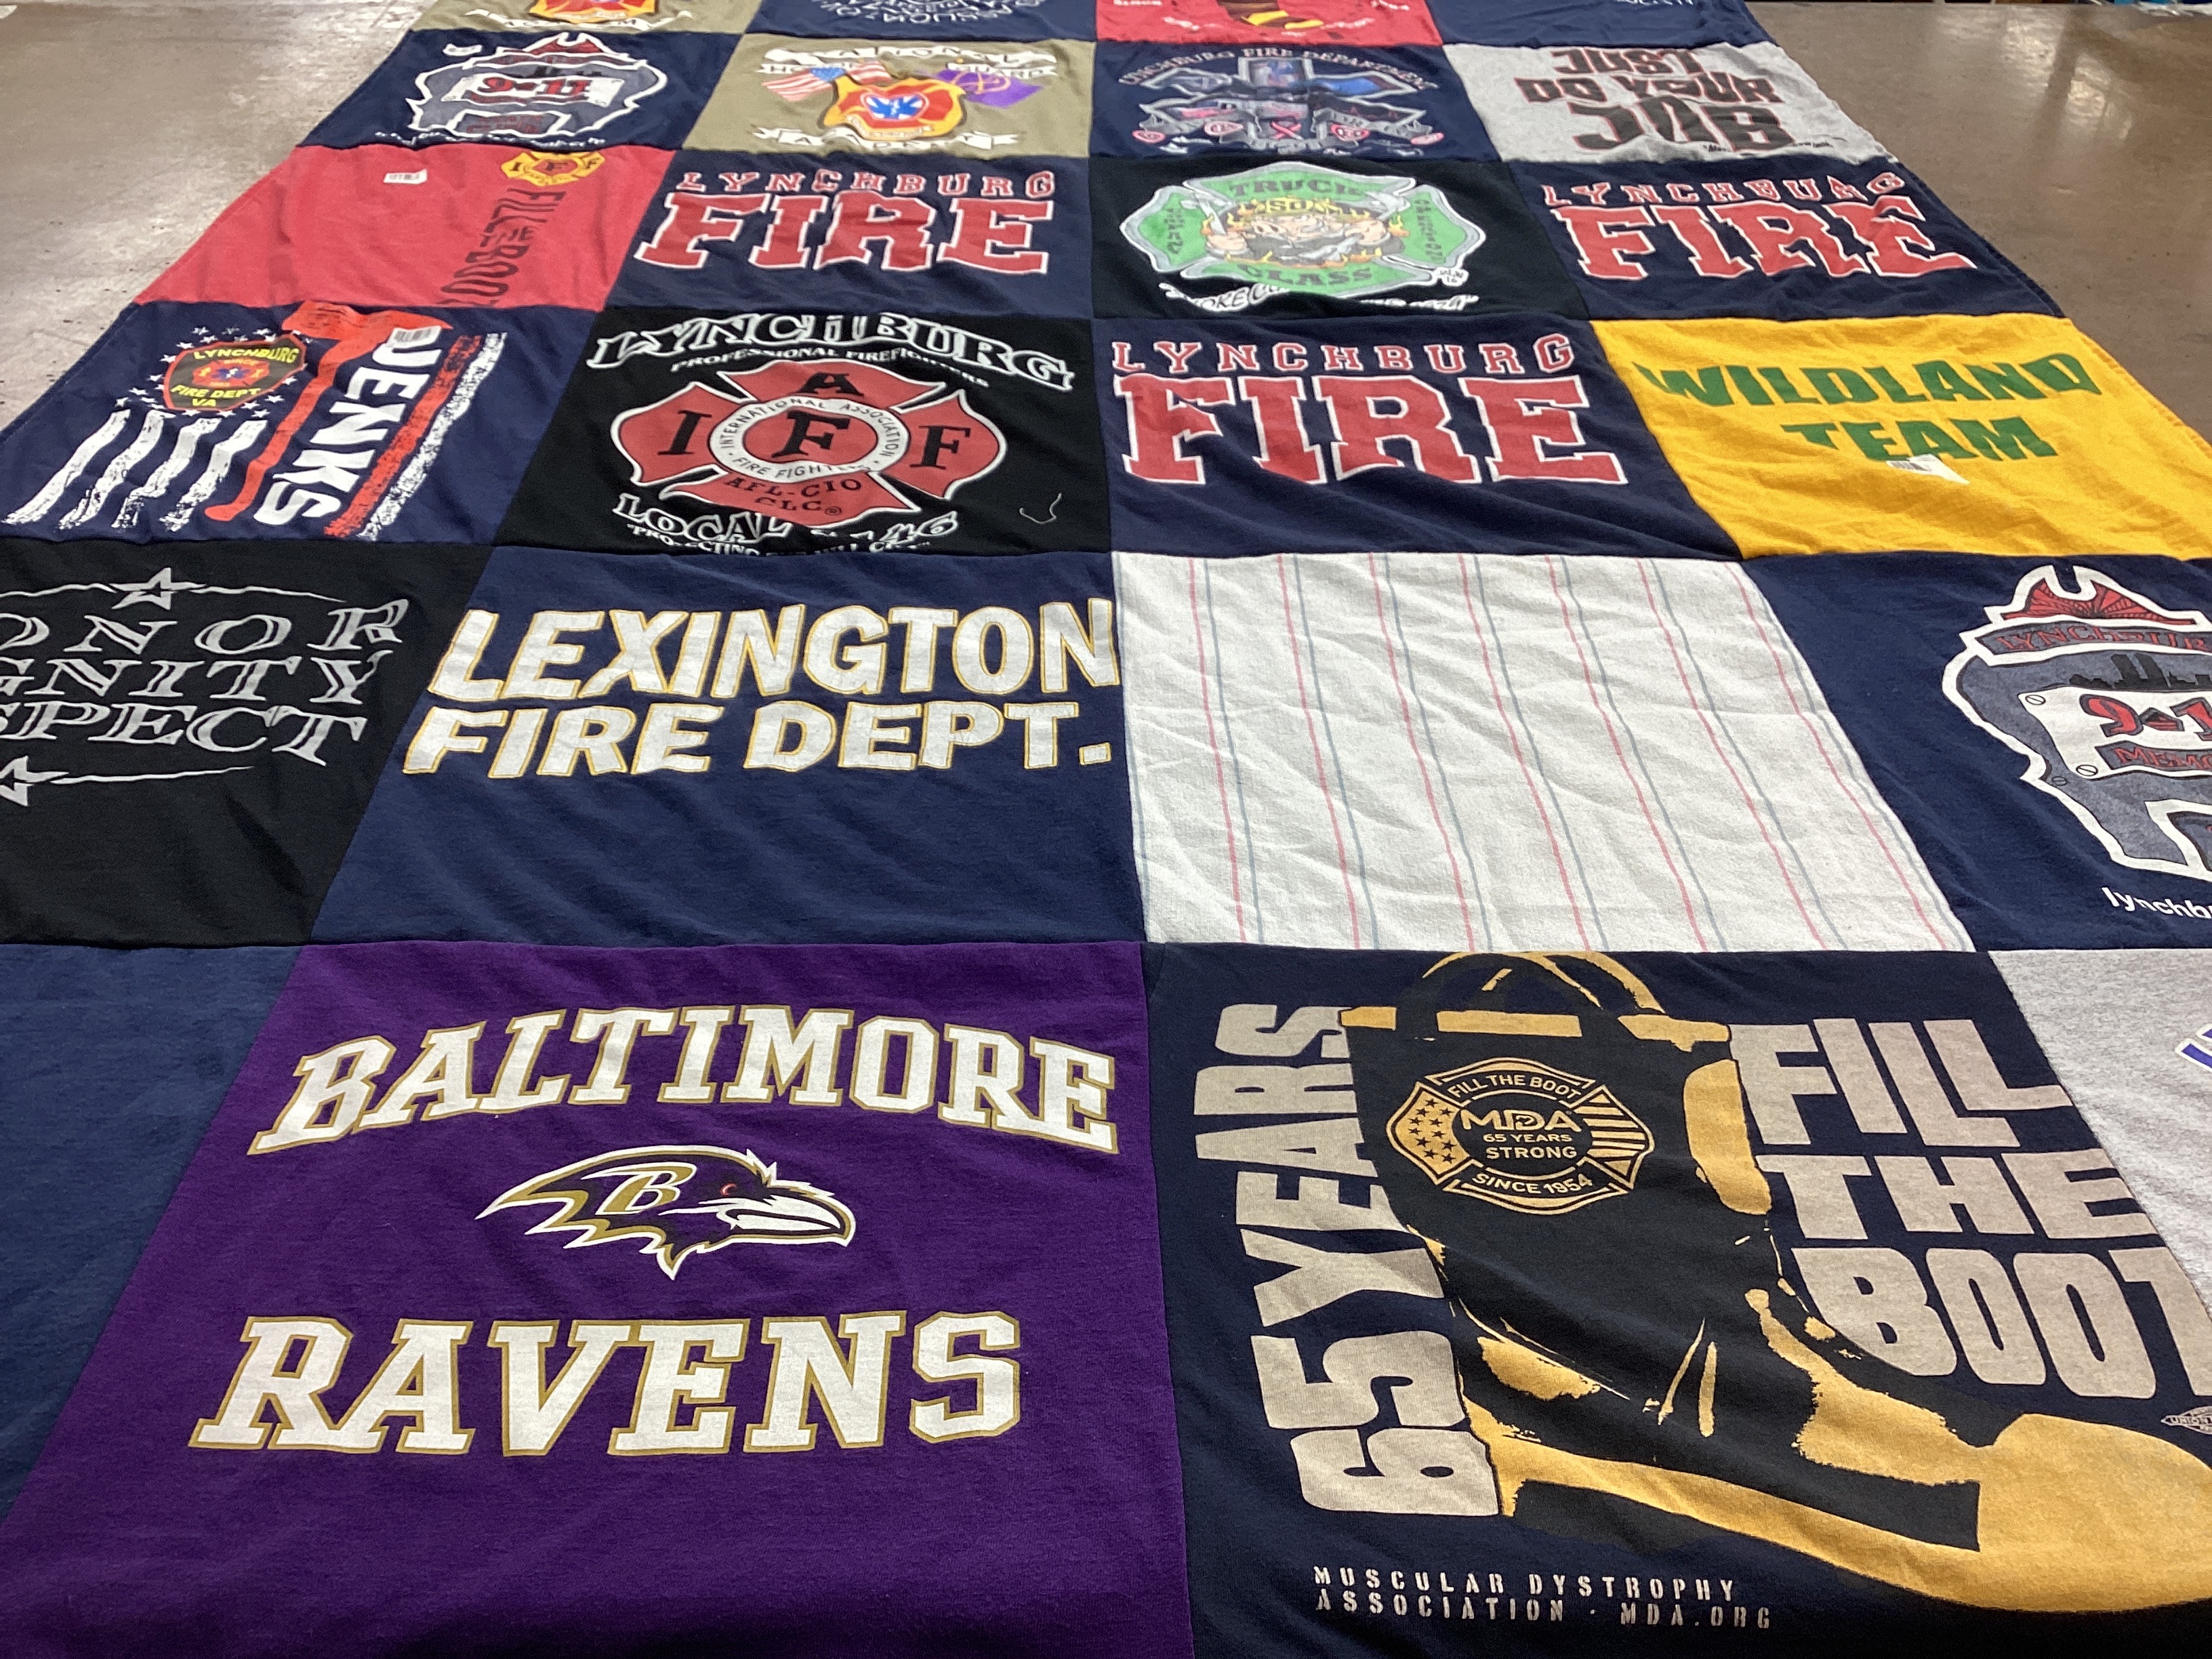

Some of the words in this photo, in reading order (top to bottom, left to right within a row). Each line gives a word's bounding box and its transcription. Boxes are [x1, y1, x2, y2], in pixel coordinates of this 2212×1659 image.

[1242, 47, 1293, 58] FIRE
[1551, 48, 1703, 74] JUST
[1513, 77, 1607, 103] DO
[1610, 71, 1785, 104] YOUR
[1566, 97, 1795, 152] JOB
[676, 169, 1055, 199] LYNCHBURG
[1541, 171, 1907, 206] LYNCHBURG
[634, 190, 1055, 275] FIRE
[1550, 194, 1978, 281] FIRE
[193, 346, 300, 364] LYNCHBURG
[586, 312, 1076, 391] LYNCHBURG
[670, 347, 840, 373] PROFESSIONAL
[1111, 331, 1574, 374] LYNCHBURG
[171, 384, 209, 398] FIRE
[210, 387, 262, 399] DEPT
[192, 398, 217, 407] VA
[800, 371, 865, 397] A
[1630, 352, 2103, 408] WILDLAND
[657, 409, 713, 455] I
[771, 409, 851, 459] F
[910, 424, 972, 470] F
[719, 397, 825, 449] INTERNATIONAL
[840, 403, 901, 457] ASSOCIATION
[1113, 371, 1629, 485] FIRE
[1780, 415, 2060, 463] TEAM
[723, 476, 862, 497] AFL-CIO
[732, 456, 772, 475] FIRE
[611, 493, 794, 544] LOCAL
[428, 598, 1122, 702] LEXINGTON
[403, 703, 725, 780] FIRE
[743, 699, 1112, 772] DEPT.
[247, 1004, 1120, 1158] BALTIMORE
[1448, 1078, 1488, 1099] FILL
[1486, 1075, 1525, 1088] THE
[1530, 1076, 1582, 1100] BOOT
[1729, 1017, 2074, 1147] FILL
[1460, 1109, 1582, 1133] MDA
[1483, 1134, 1507, 1143] 65
[1511, 1134, 1573, 1143] YEARS
[1193, 1003, 1446, 1326] YEARS
[1486, 1147, 1578, 1160] STRONG
[581, 1161, 698, 1216] B
[1471, 1172, 1542, 1194] SINCE
[1544, 1173, 1594, 1195] 1954
[1755, 1148, 2164, 1240] THE
[1791, 1246, 2212, 1399] BOOT
[187, 1310, 1021, 1458] RAVENS
[1250, 1330, 1499, 1517] 65
[1313, 1566, 1504, 1595] MUSCULAR
[1529, 1573, 1734, 1601] DYSTROPHY
[1315, 1591, 1564, 1622] ASSOCIATION
[1620, 1602, 1770, 1629] MDA.ORG
